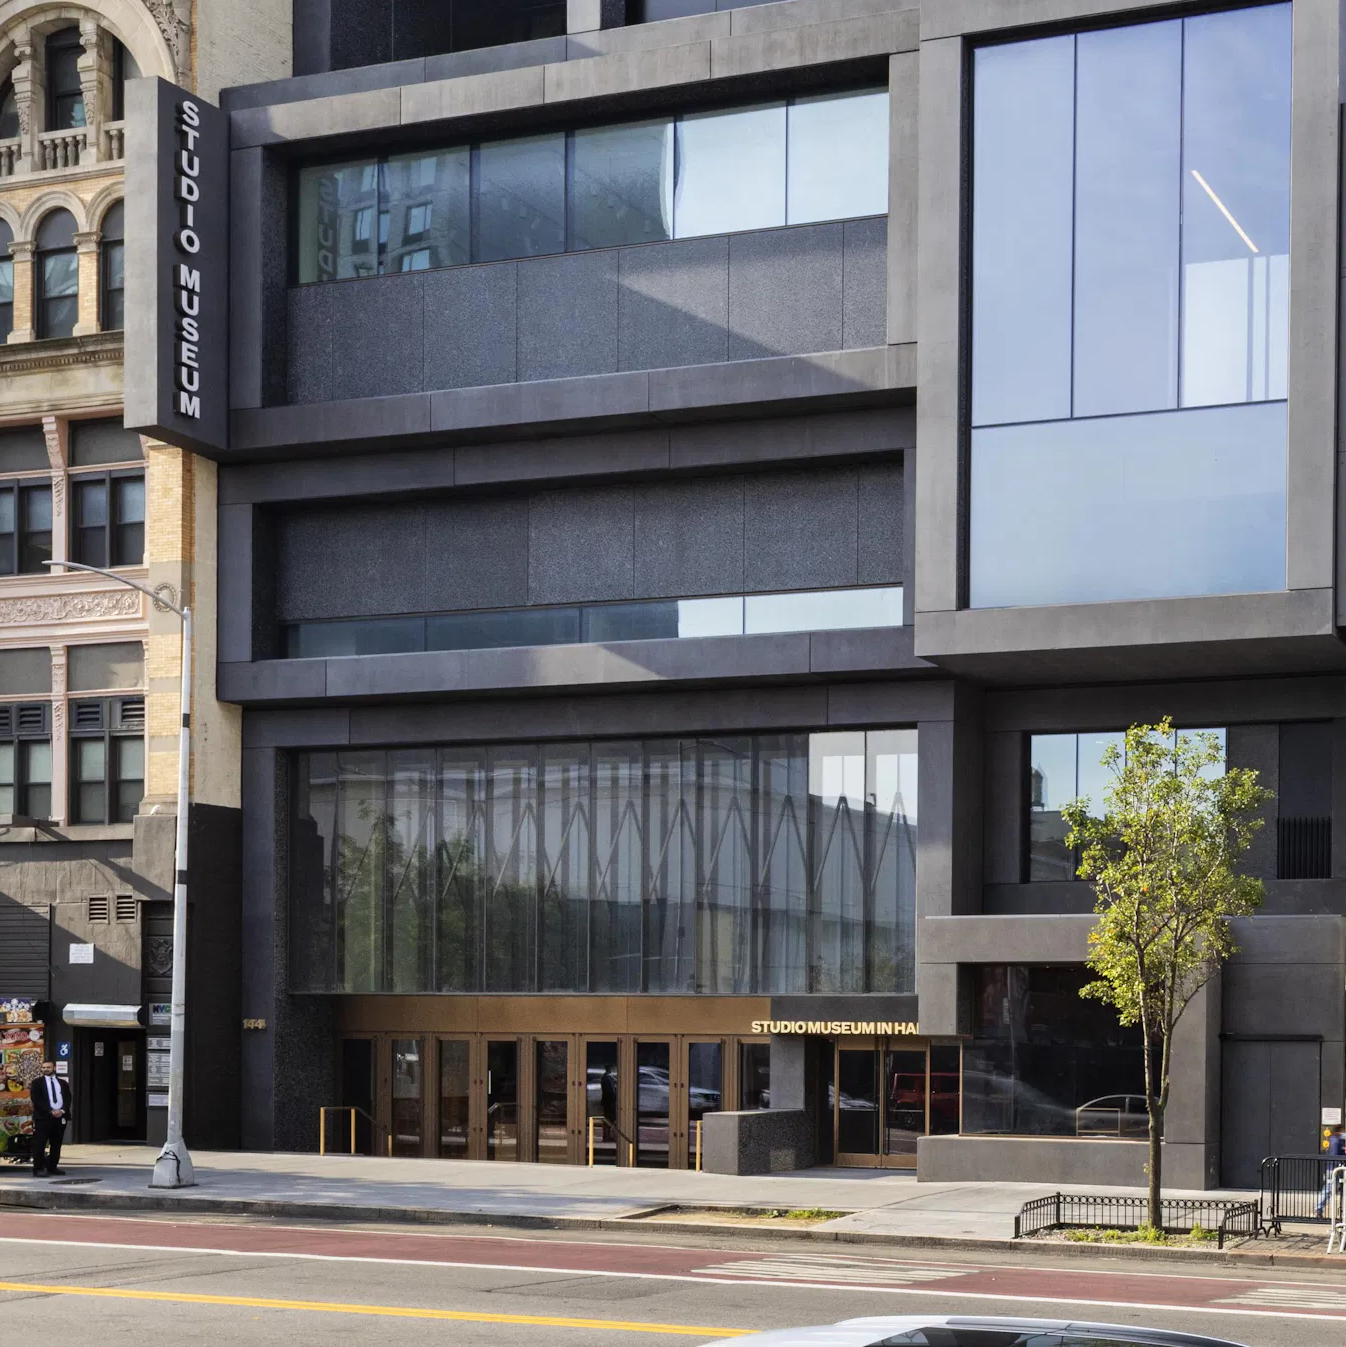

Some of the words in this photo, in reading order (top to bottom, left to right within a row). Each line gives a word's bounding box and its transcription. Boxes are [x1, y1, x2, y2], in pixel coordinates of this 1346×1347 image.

[180, 100, 201, 254] STUDIO
[180, 263, 201, 419] MUSEUM
[751, 1021, 806, 1034] STUDIO
[808, 1022, 876, 1034] MUSEUM
[877, 1022, 892, 1034] IN
